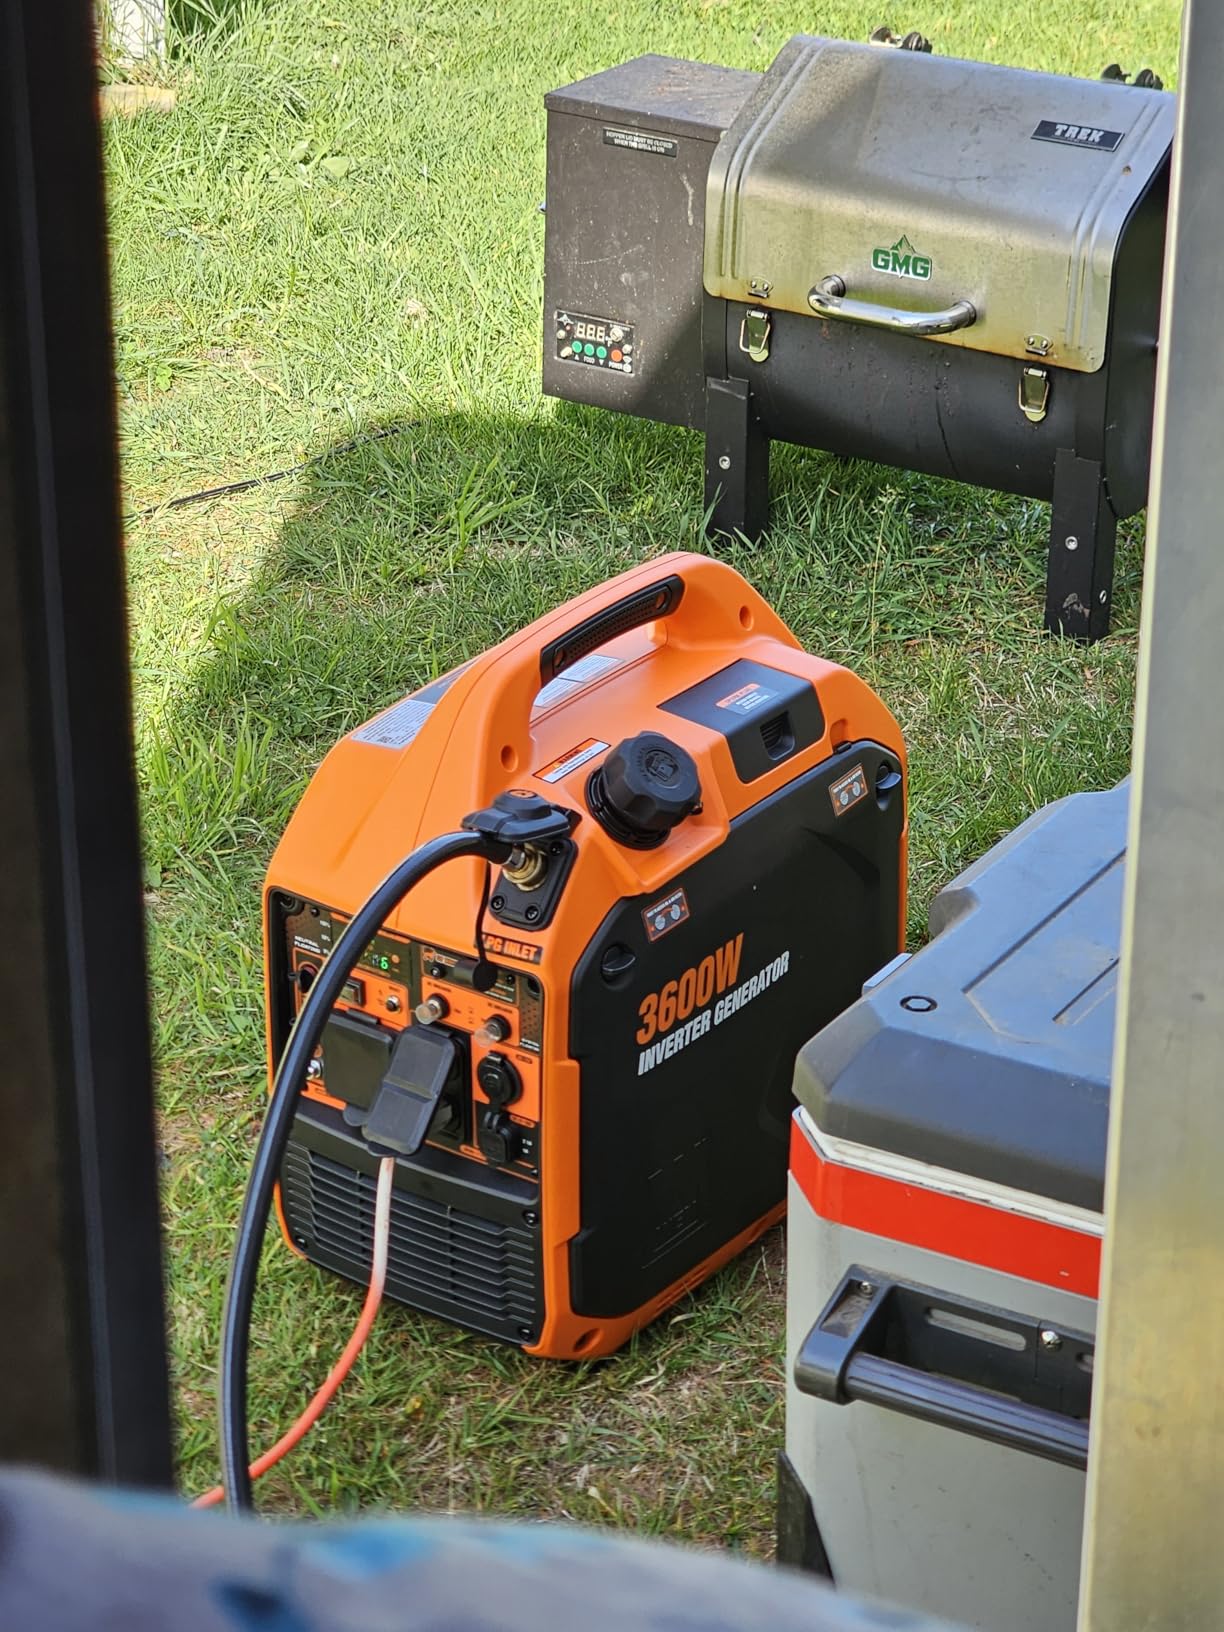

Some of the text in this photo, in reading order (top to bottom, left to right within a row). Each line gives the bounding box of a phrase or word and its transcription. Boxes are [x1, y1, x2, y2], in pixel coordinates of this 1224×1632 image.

[1054, 123, 1104, 143] TREK
[872, 248, 930, 279] GMG
[380, 956, 389, 970] 6
[503, 939, 538, 961] INLET
[636, 932, 745, 1045] 3600W
[637, 950, 790, 1076] INVERTER GENERATOR
